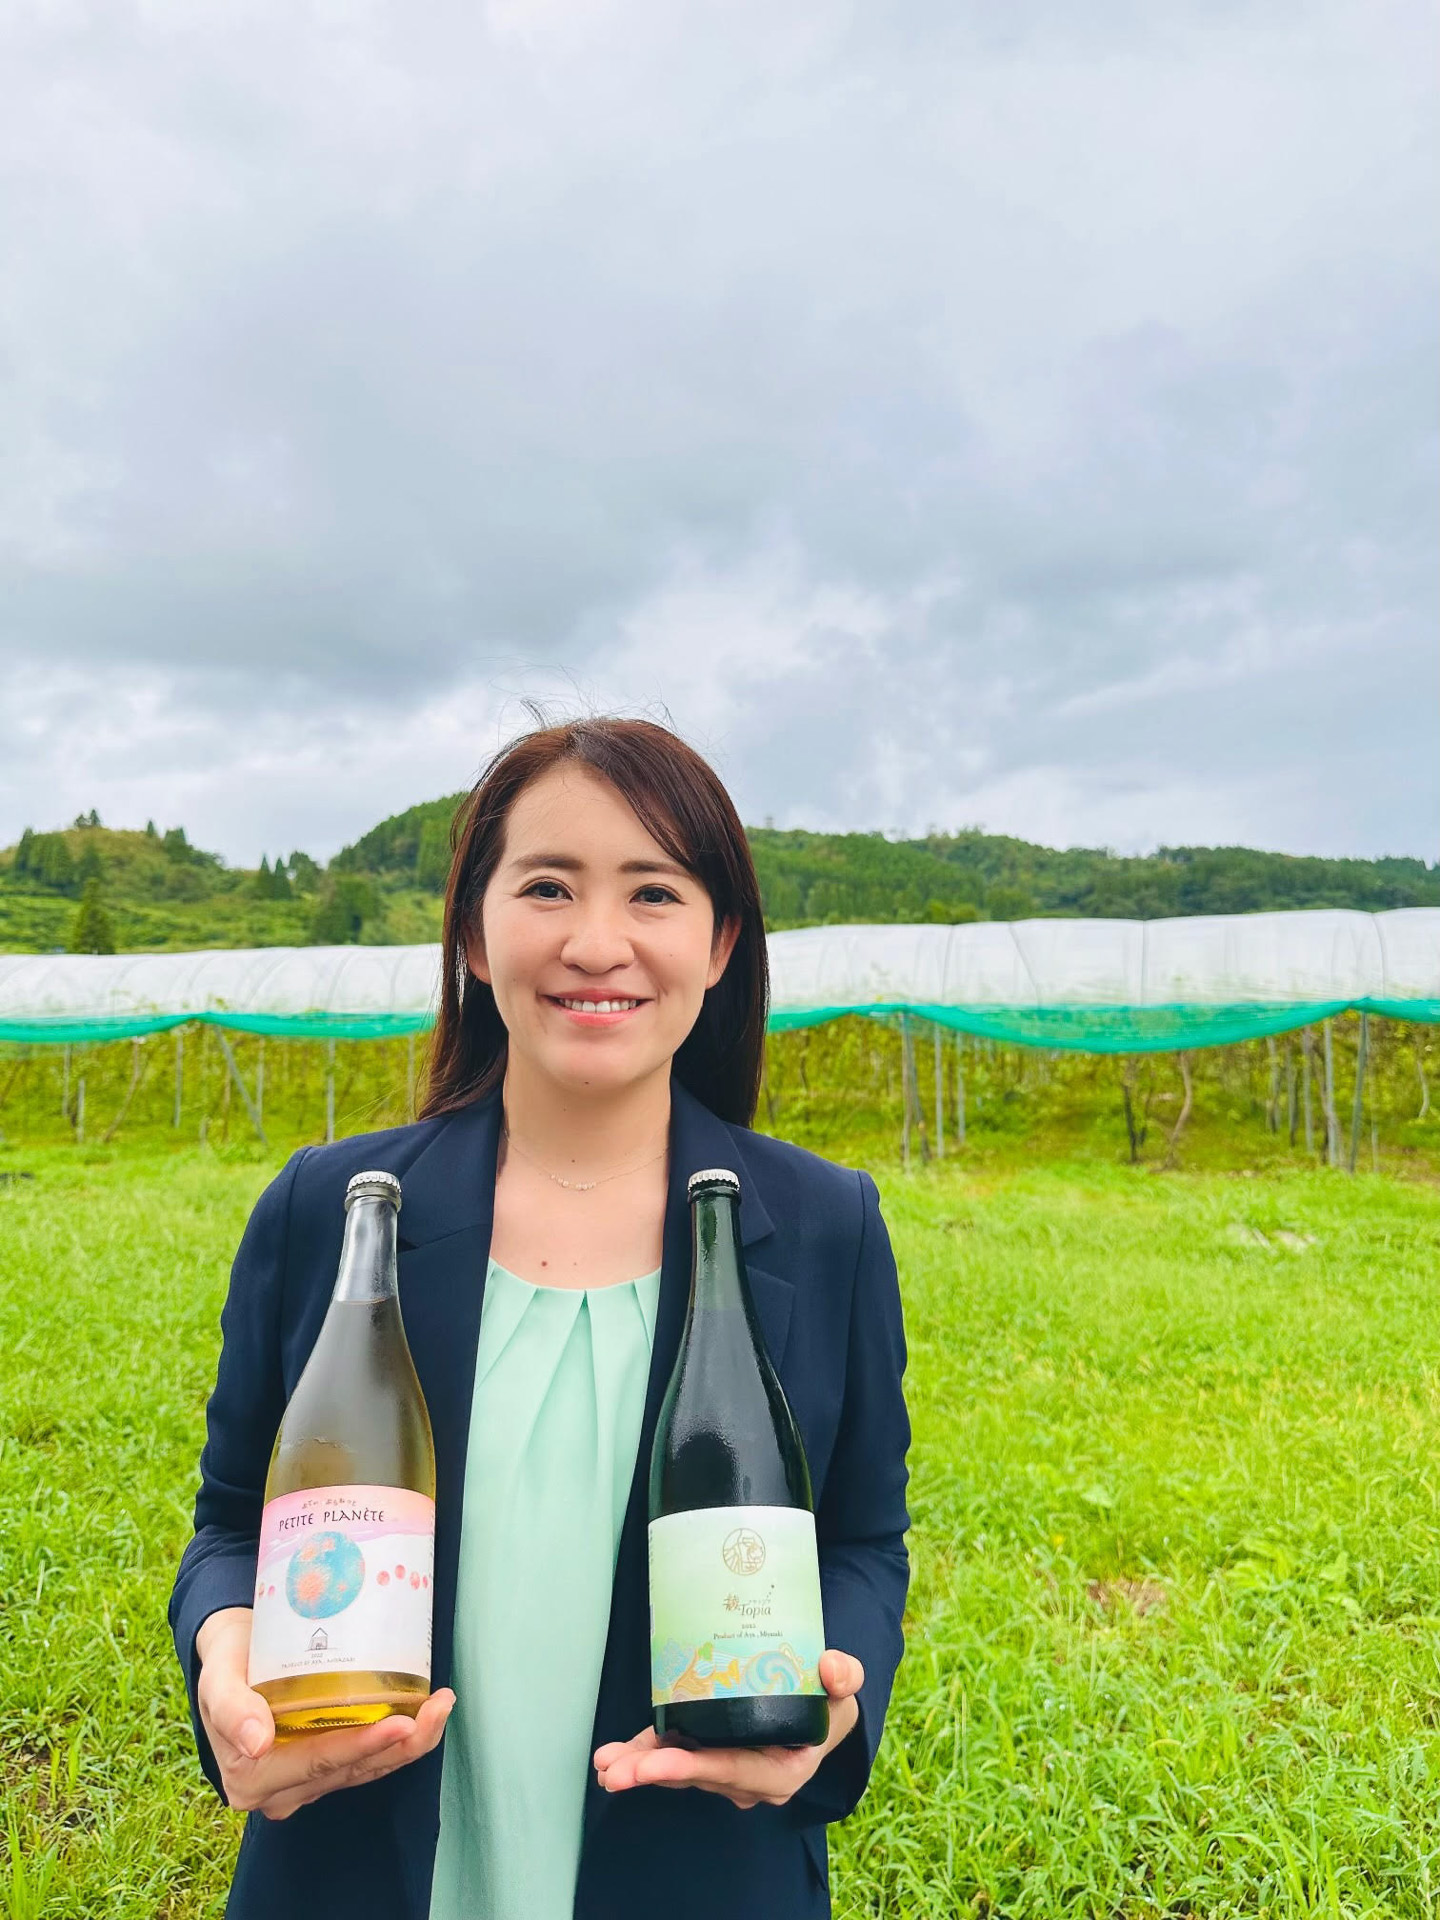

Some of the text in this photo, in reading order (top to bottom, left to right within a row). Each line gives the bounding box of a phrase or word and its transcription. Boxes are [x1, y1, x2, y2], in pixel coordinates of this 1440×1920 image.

[278, 1507, 385, 1532] PETITE PLANÈTE
[713, 1631, 736, 1640] Product
[736, 1630, 743, 1638] of
